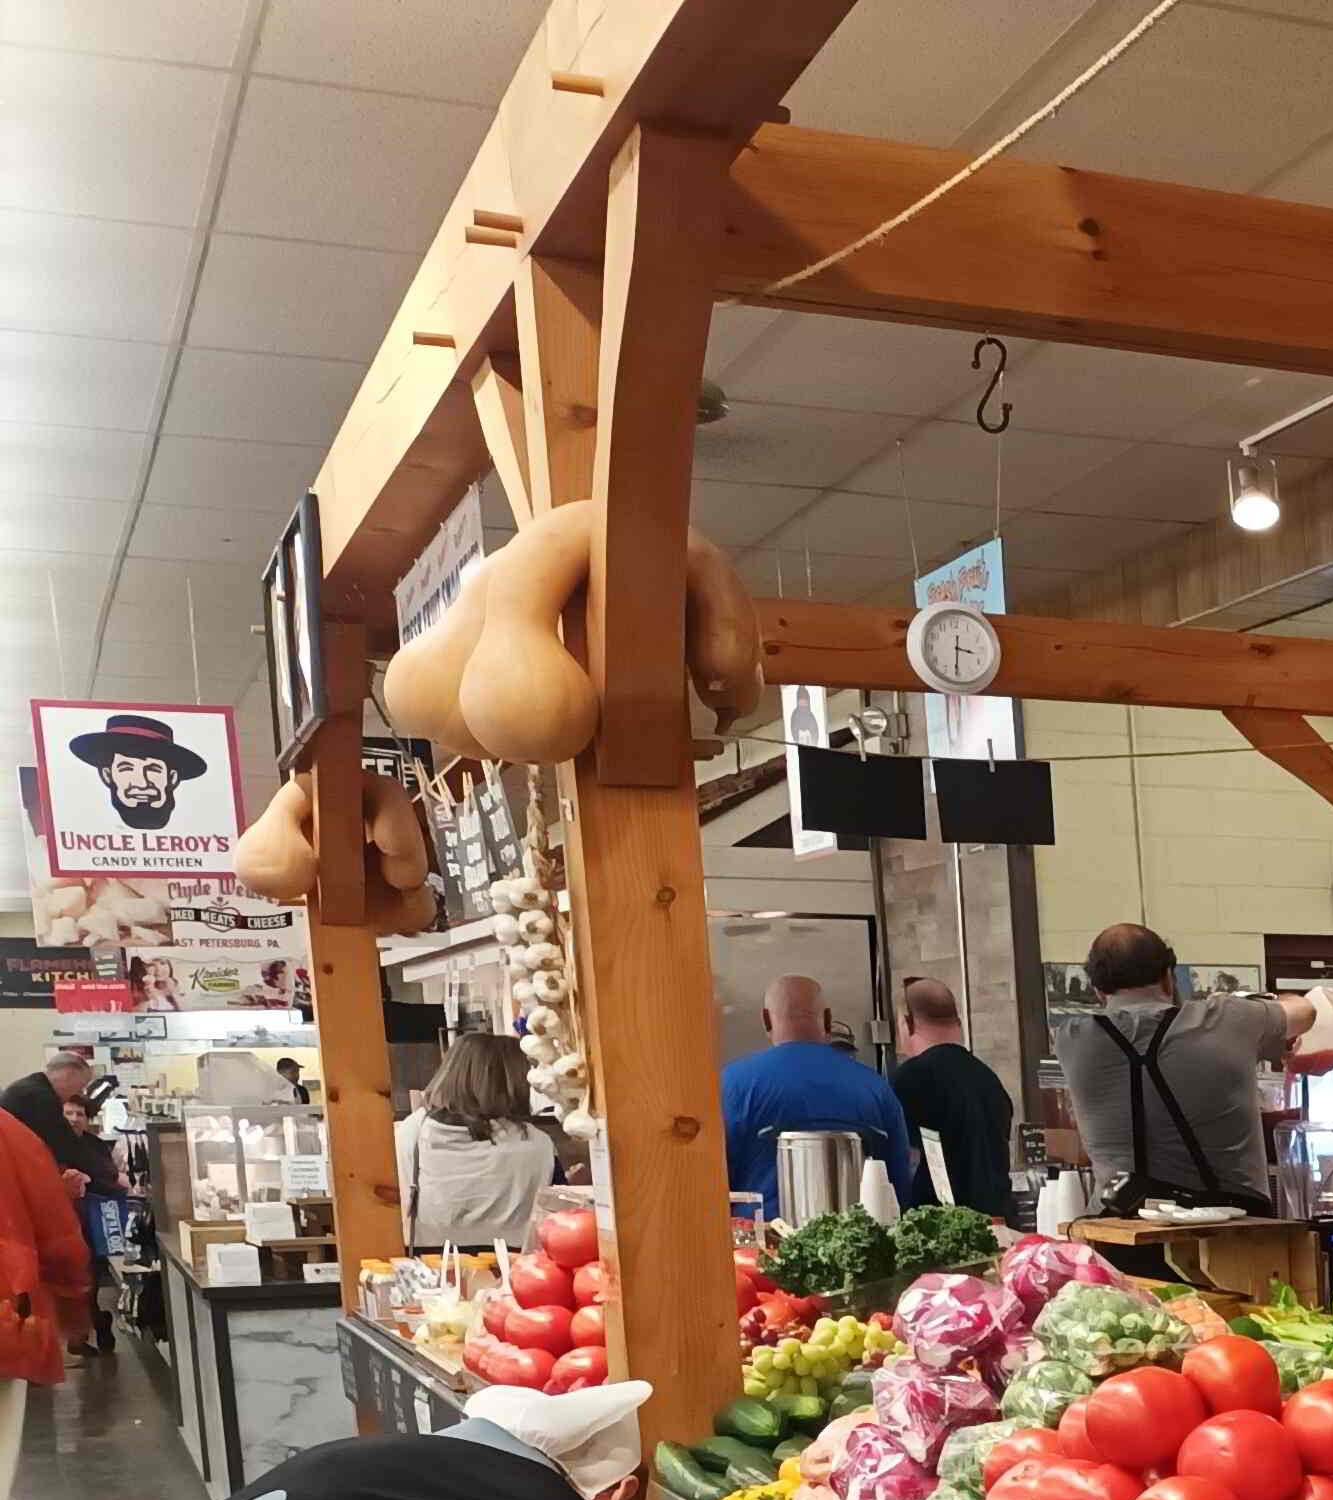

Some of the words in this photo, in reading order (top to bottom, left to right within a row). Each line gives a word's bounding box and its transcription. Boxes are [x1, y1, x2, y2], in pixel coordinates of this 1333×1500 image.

[60, 831, 136, 852] UNCLE
[142, 832, 231, 853] LEROY'S
[91, 856, 138, 868] CANDY
[143, 856, 203, 868] KITCHEN
[247, 913, 288, 929] CHEESE
[174, 938, 194, 948] AST
